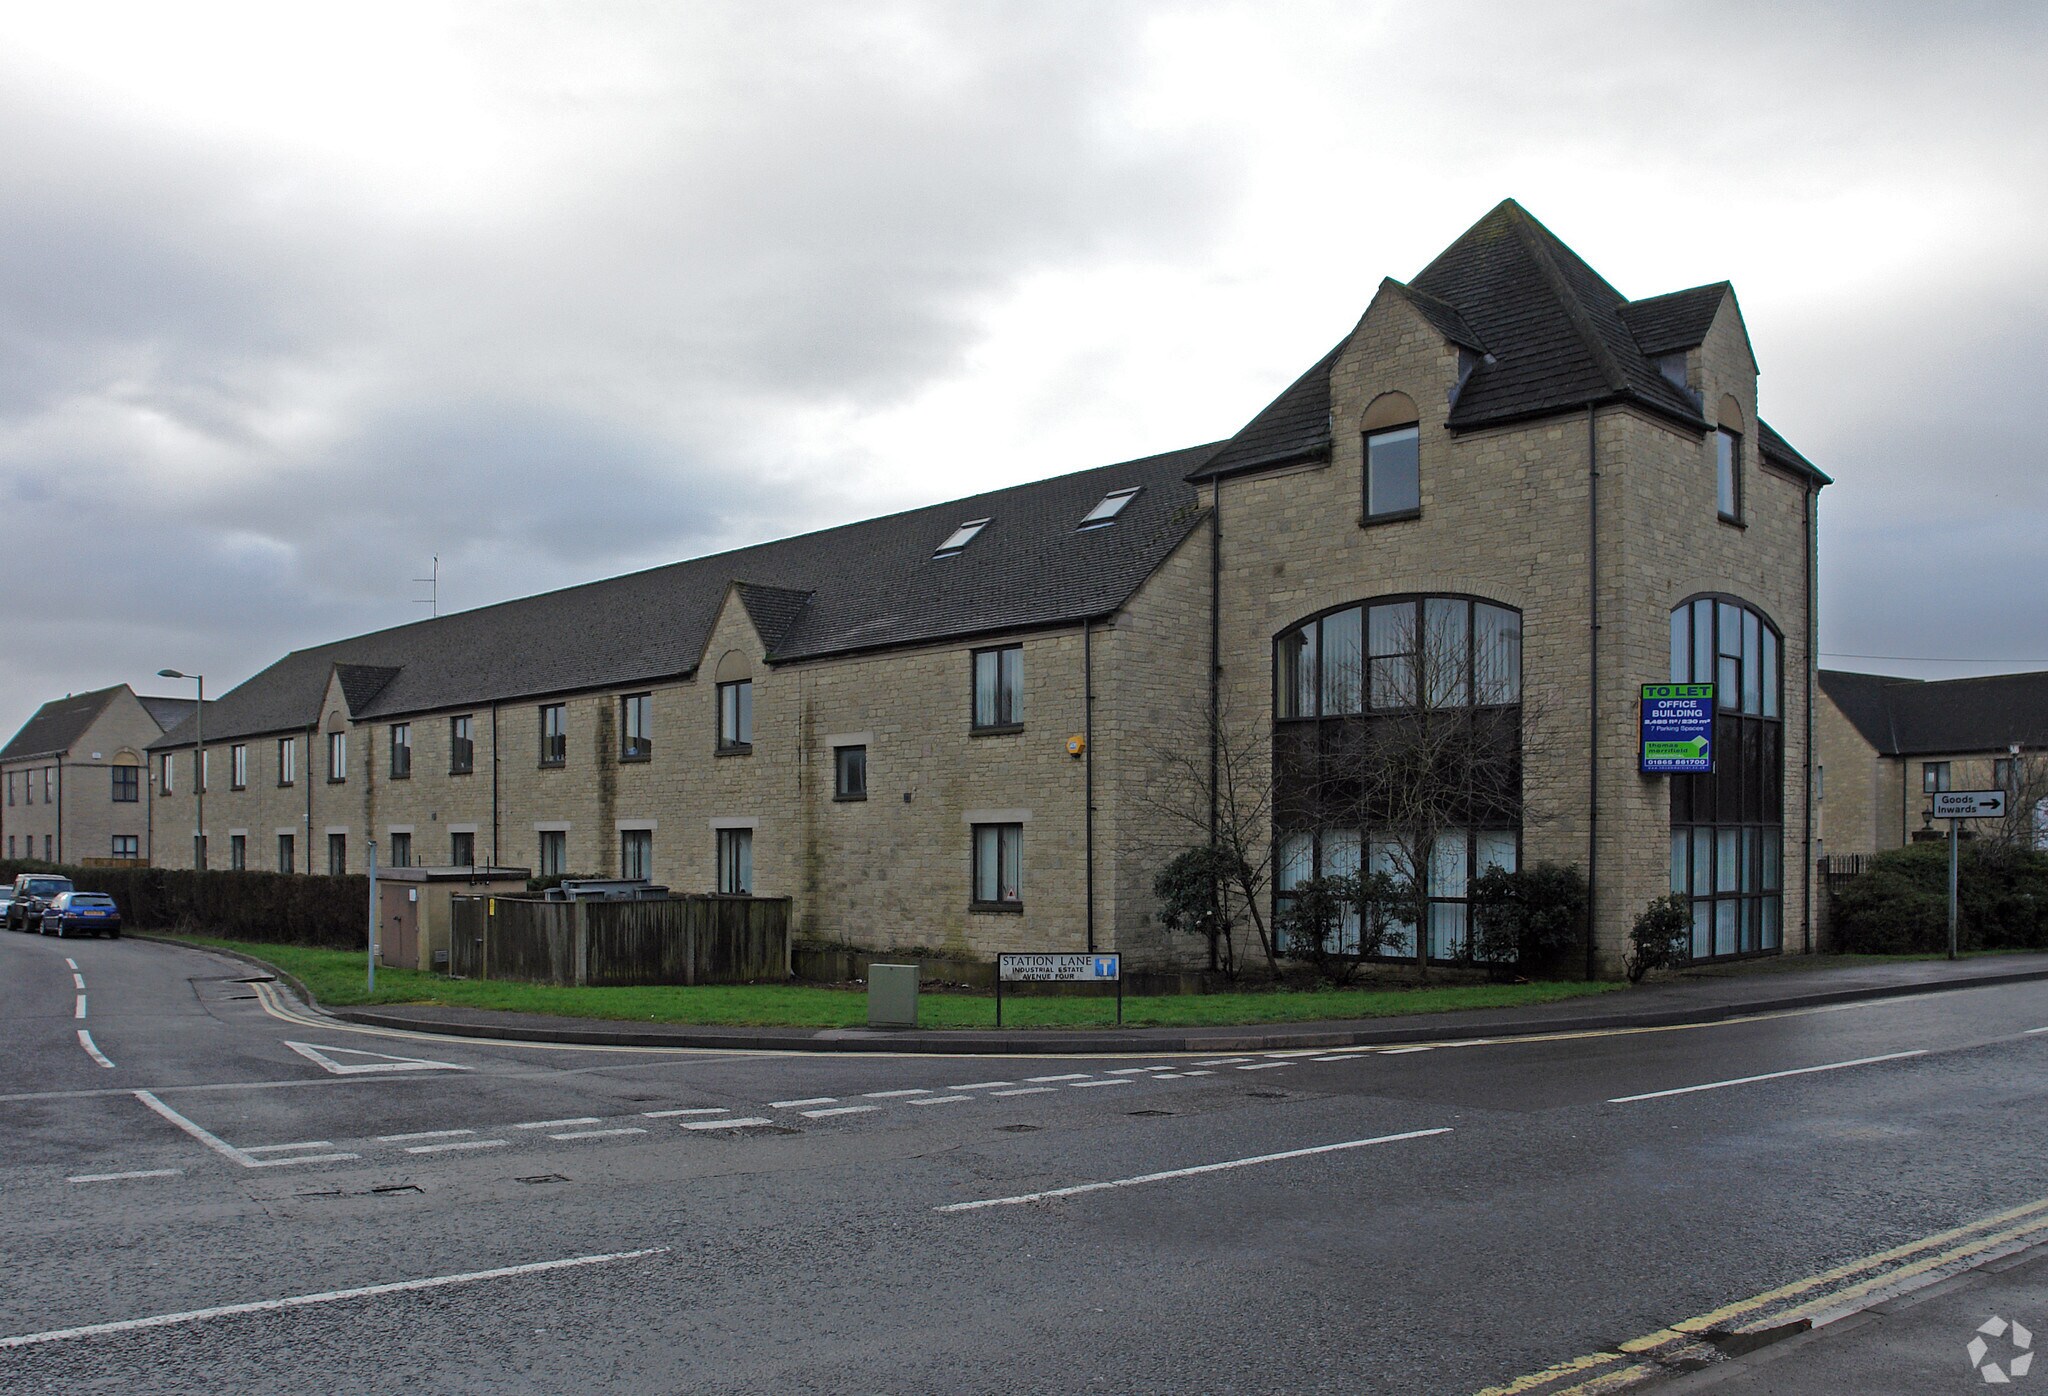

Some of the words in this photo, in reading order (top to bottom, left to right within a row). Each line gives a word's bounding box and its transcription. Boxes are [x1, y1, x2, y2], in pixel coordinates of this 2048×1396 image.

[1646, 687, 1671, 696] TO
[1675, 687, 1711, 696] LET
[1658, 700, 1697, 708] OFFICE
[1652, 709, 1703, 717] BUILDING
[1942, 795, 1974, 804] Goods
[1938, 805, 1977, 813] Inwards
[1003, 956, 1054, 966] STATION
[1061, 956, 1092, 966] LANE
